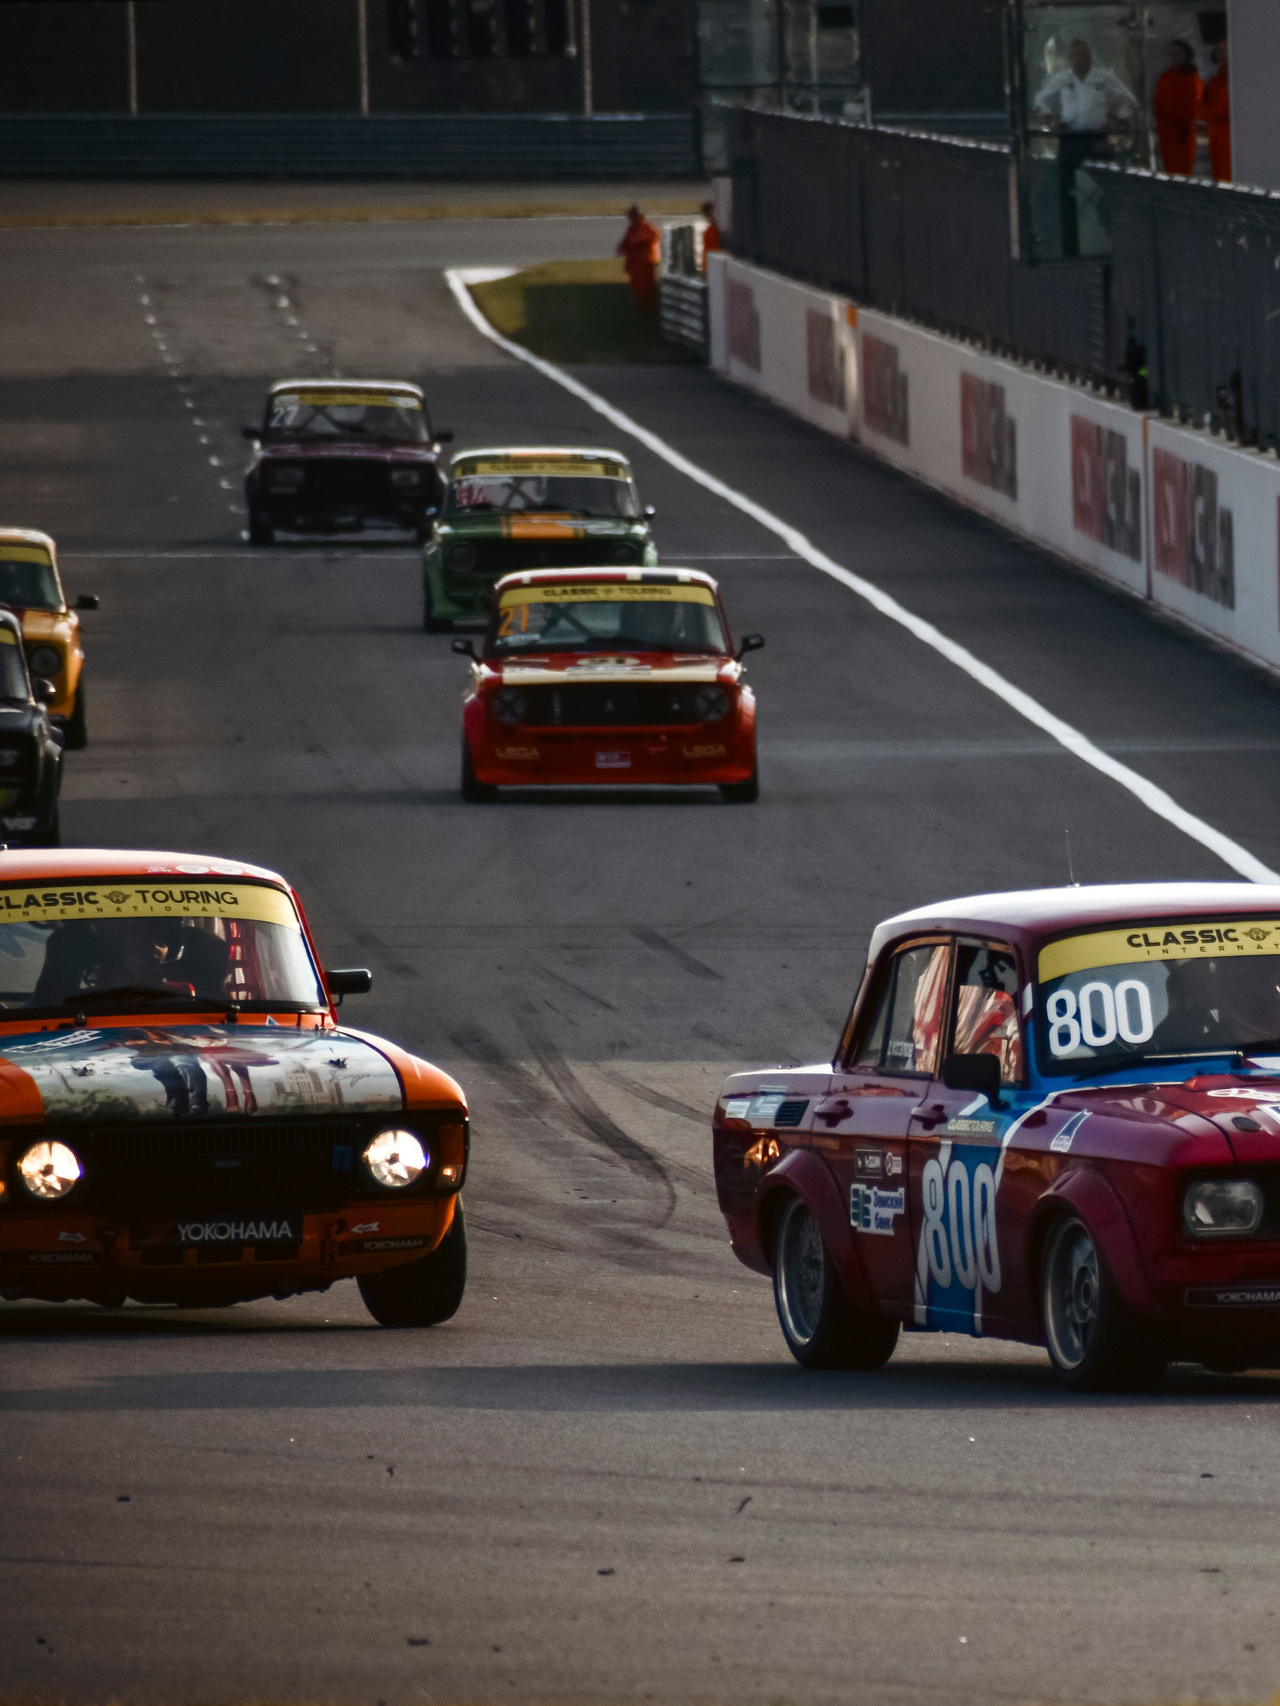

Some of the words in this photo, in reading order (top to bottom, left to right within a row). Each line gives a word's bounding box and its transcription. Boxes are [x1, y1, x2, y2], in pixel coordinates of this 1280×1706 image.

[135, 889, 239, 907] TOURING
[8, 905, 226, 918] INTERNATIONAL
[1126, 928, 1239, 948] CLASSIC
[1046, 979, 1152, 1056] 800
[177, 1221, 293, 1241] YOKOHAMA
[921, 1158, 1001, 1294] 800
[363, 1239, 425, 1251] YOKOHAMA
